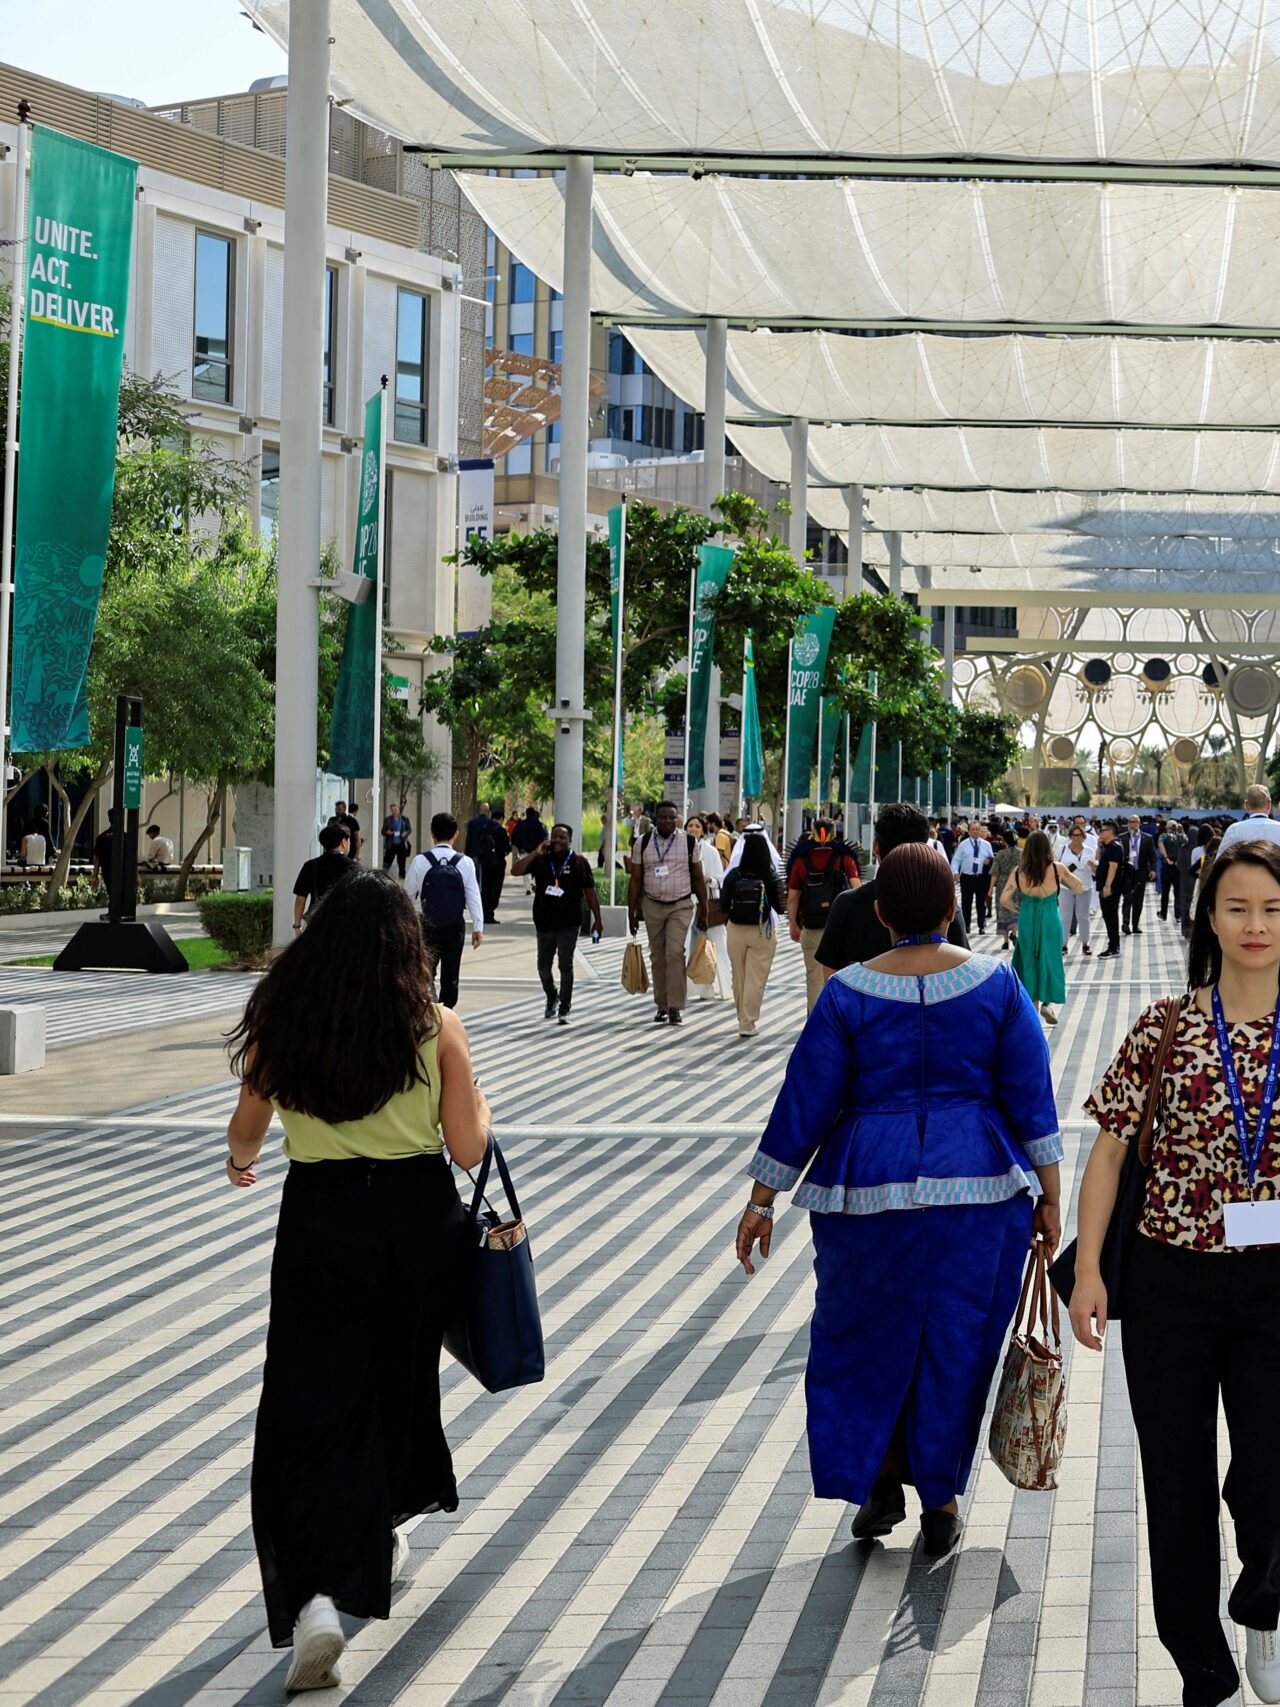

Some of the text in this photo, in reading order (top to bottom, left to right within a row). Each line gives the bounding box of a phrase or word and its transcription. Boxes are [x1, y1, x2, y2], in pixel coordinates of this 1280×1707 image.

[34, 215, 98, 260] UNITE.
[30, 252, 72, 289] ACT.
[30, 288, 120, 335] DELIVER.
[464, 513, 489, 522] BUILDING
[791, 669, 820, 689] COP28
